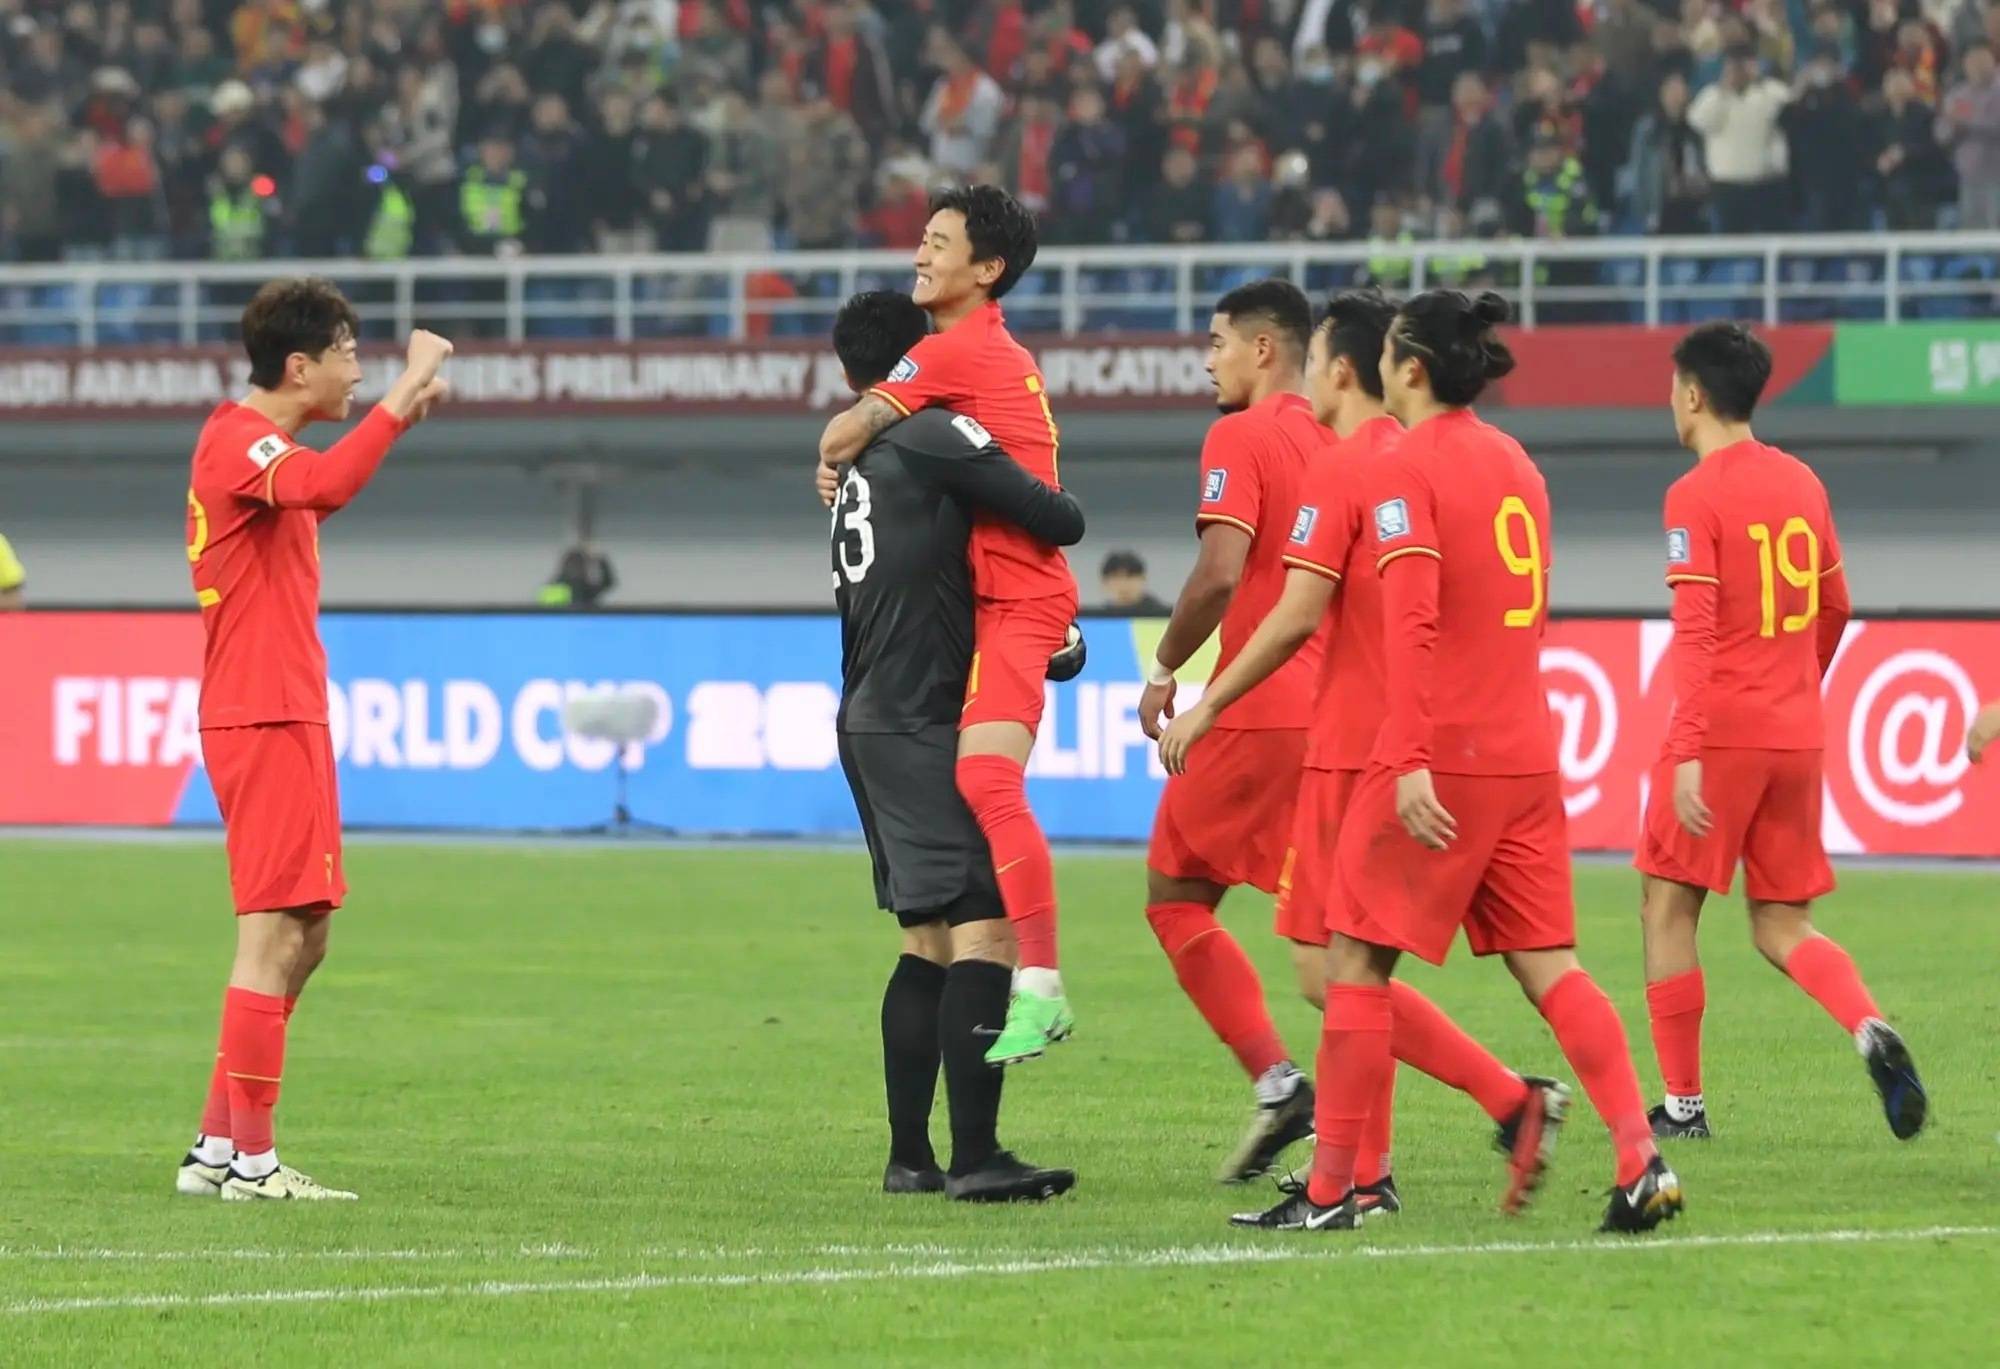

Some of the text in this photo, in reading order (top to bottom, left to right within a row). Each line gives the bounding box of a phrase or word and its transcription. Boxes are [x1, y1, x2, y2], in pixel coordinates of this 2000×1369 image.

[546, 354, 814, 401] PRELIMINARY
[831, 465, 876, 590] 3
[1493, 496, 1543, 628] 9
[1747, 516, 1819, 638] 19
[53, 675, 205, 767] FIFA
